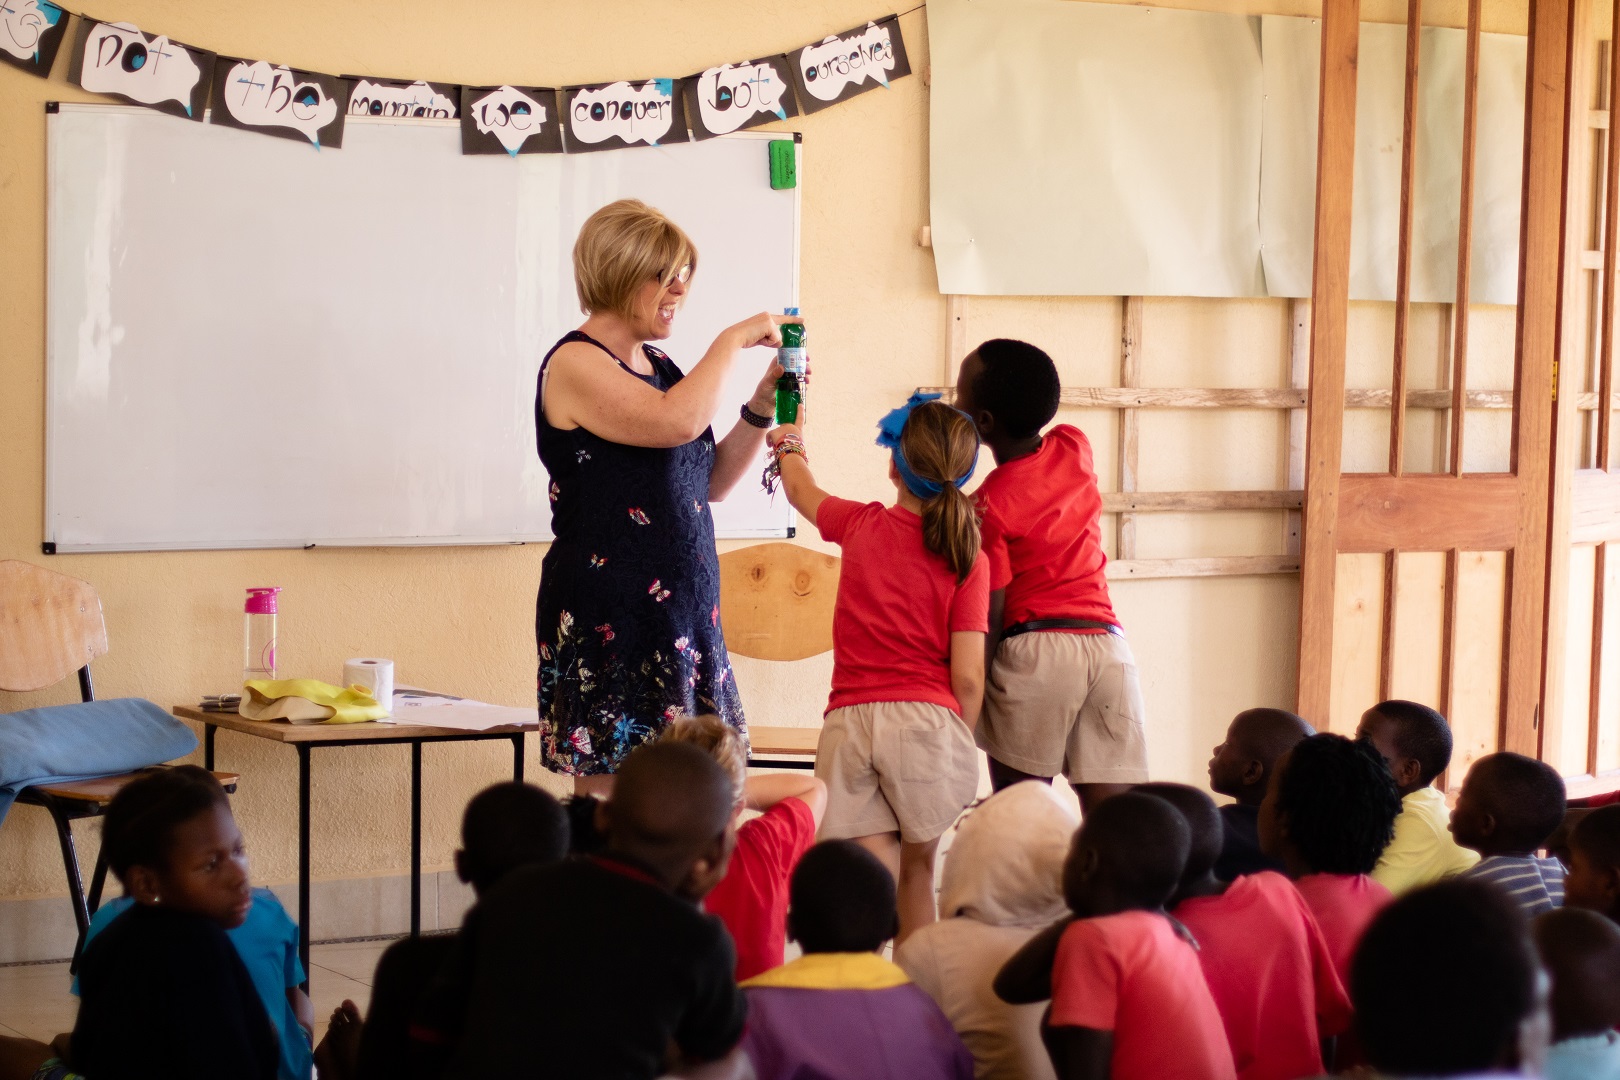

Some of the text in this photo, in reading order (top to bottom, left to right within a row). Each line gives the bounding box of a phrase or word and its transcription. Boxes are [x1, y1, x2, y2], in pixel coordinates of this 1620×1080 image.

[97, 34, 173, 75] not
[237, 70, 320, 120] the
[480, 100, 535, 130] we
[575, 97, 671, 133] conquer
[707, 68, 772, 112] but
[805, 37, 894, 83] ourselves
